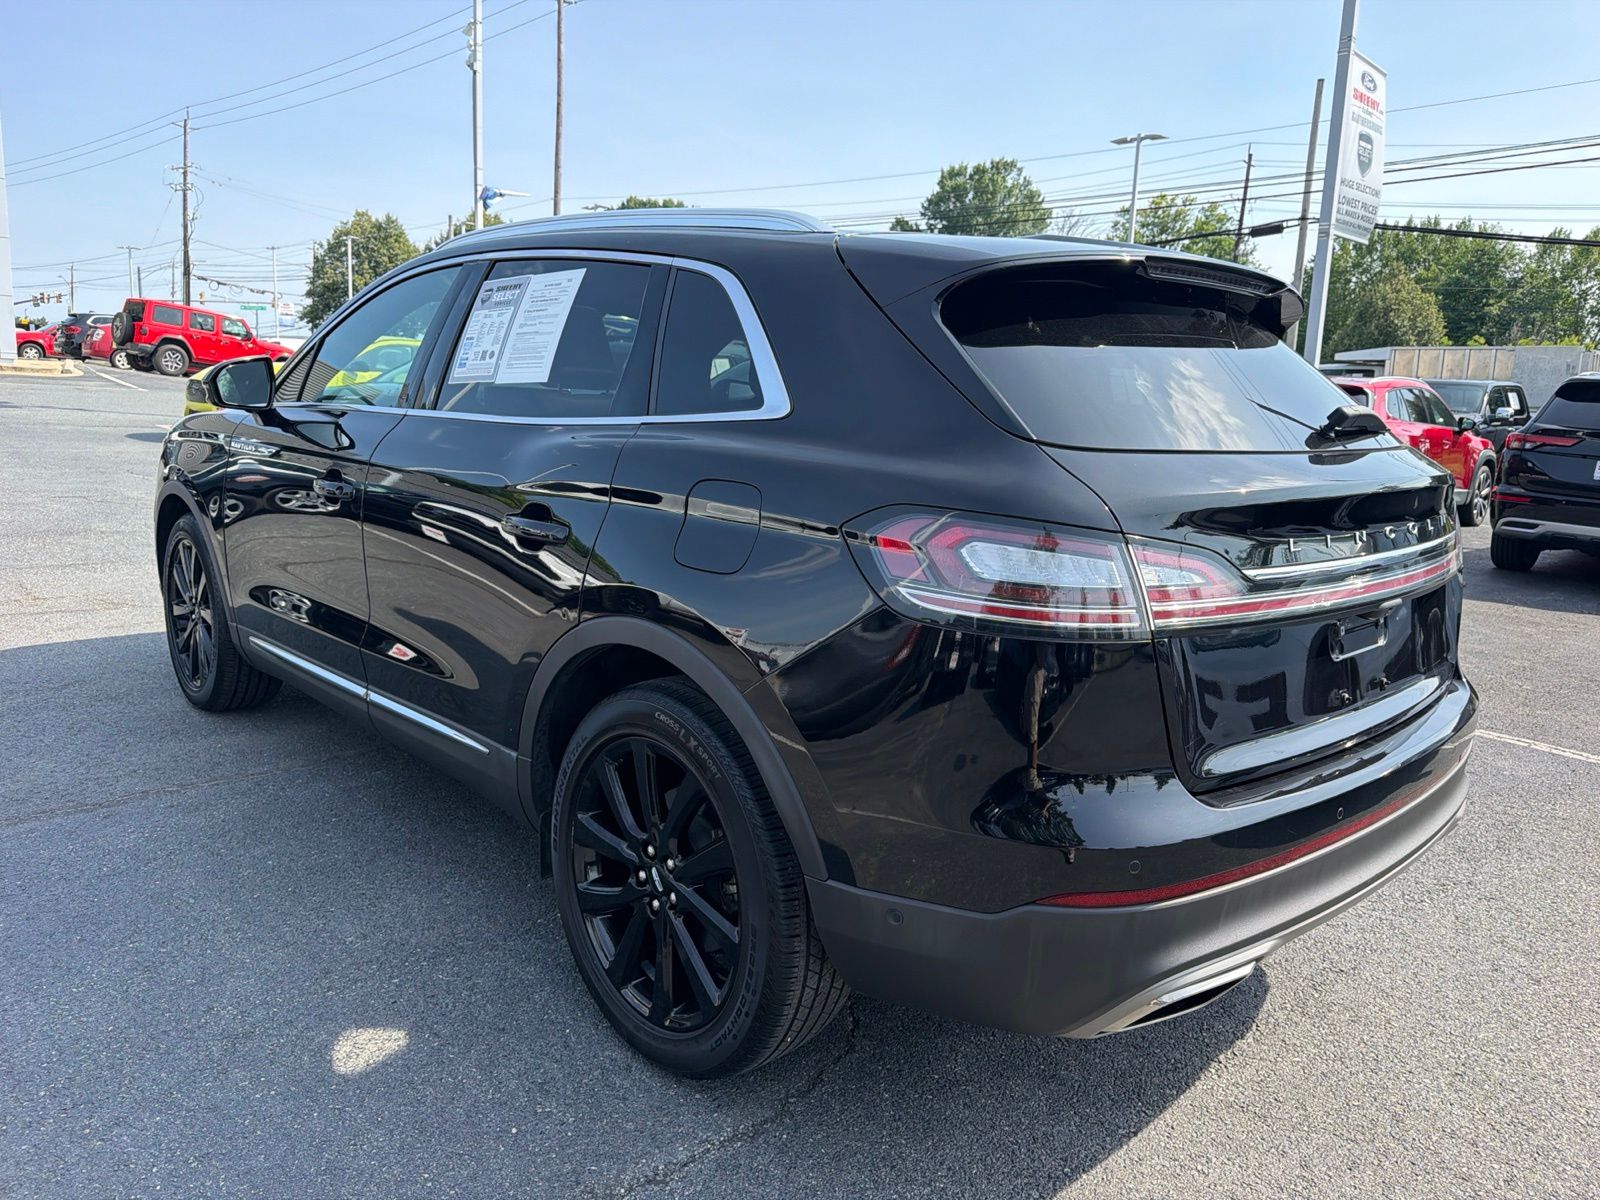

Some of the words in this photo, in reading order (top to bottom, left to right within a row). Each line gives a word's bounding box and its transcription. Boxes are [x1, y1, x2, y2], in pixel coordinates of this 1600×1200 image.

[1353, 87, 1380, 112] SHEEHY
[1340, 177, 1355, 190] HUGE
[1338, 194, 1360, 209] LOWEST
[1360, 201, 1378, 216] PRICES
[492, 290, 520, 301] SELECT
[231, 441, 256, 452] NAUTILUS
[1288, 515, 1447, 552] LINCOLN
[655, 711, 681, 732] CROSS
[679, 728, 699, 753] LX
[696, 746, 722, 778] SPORT
